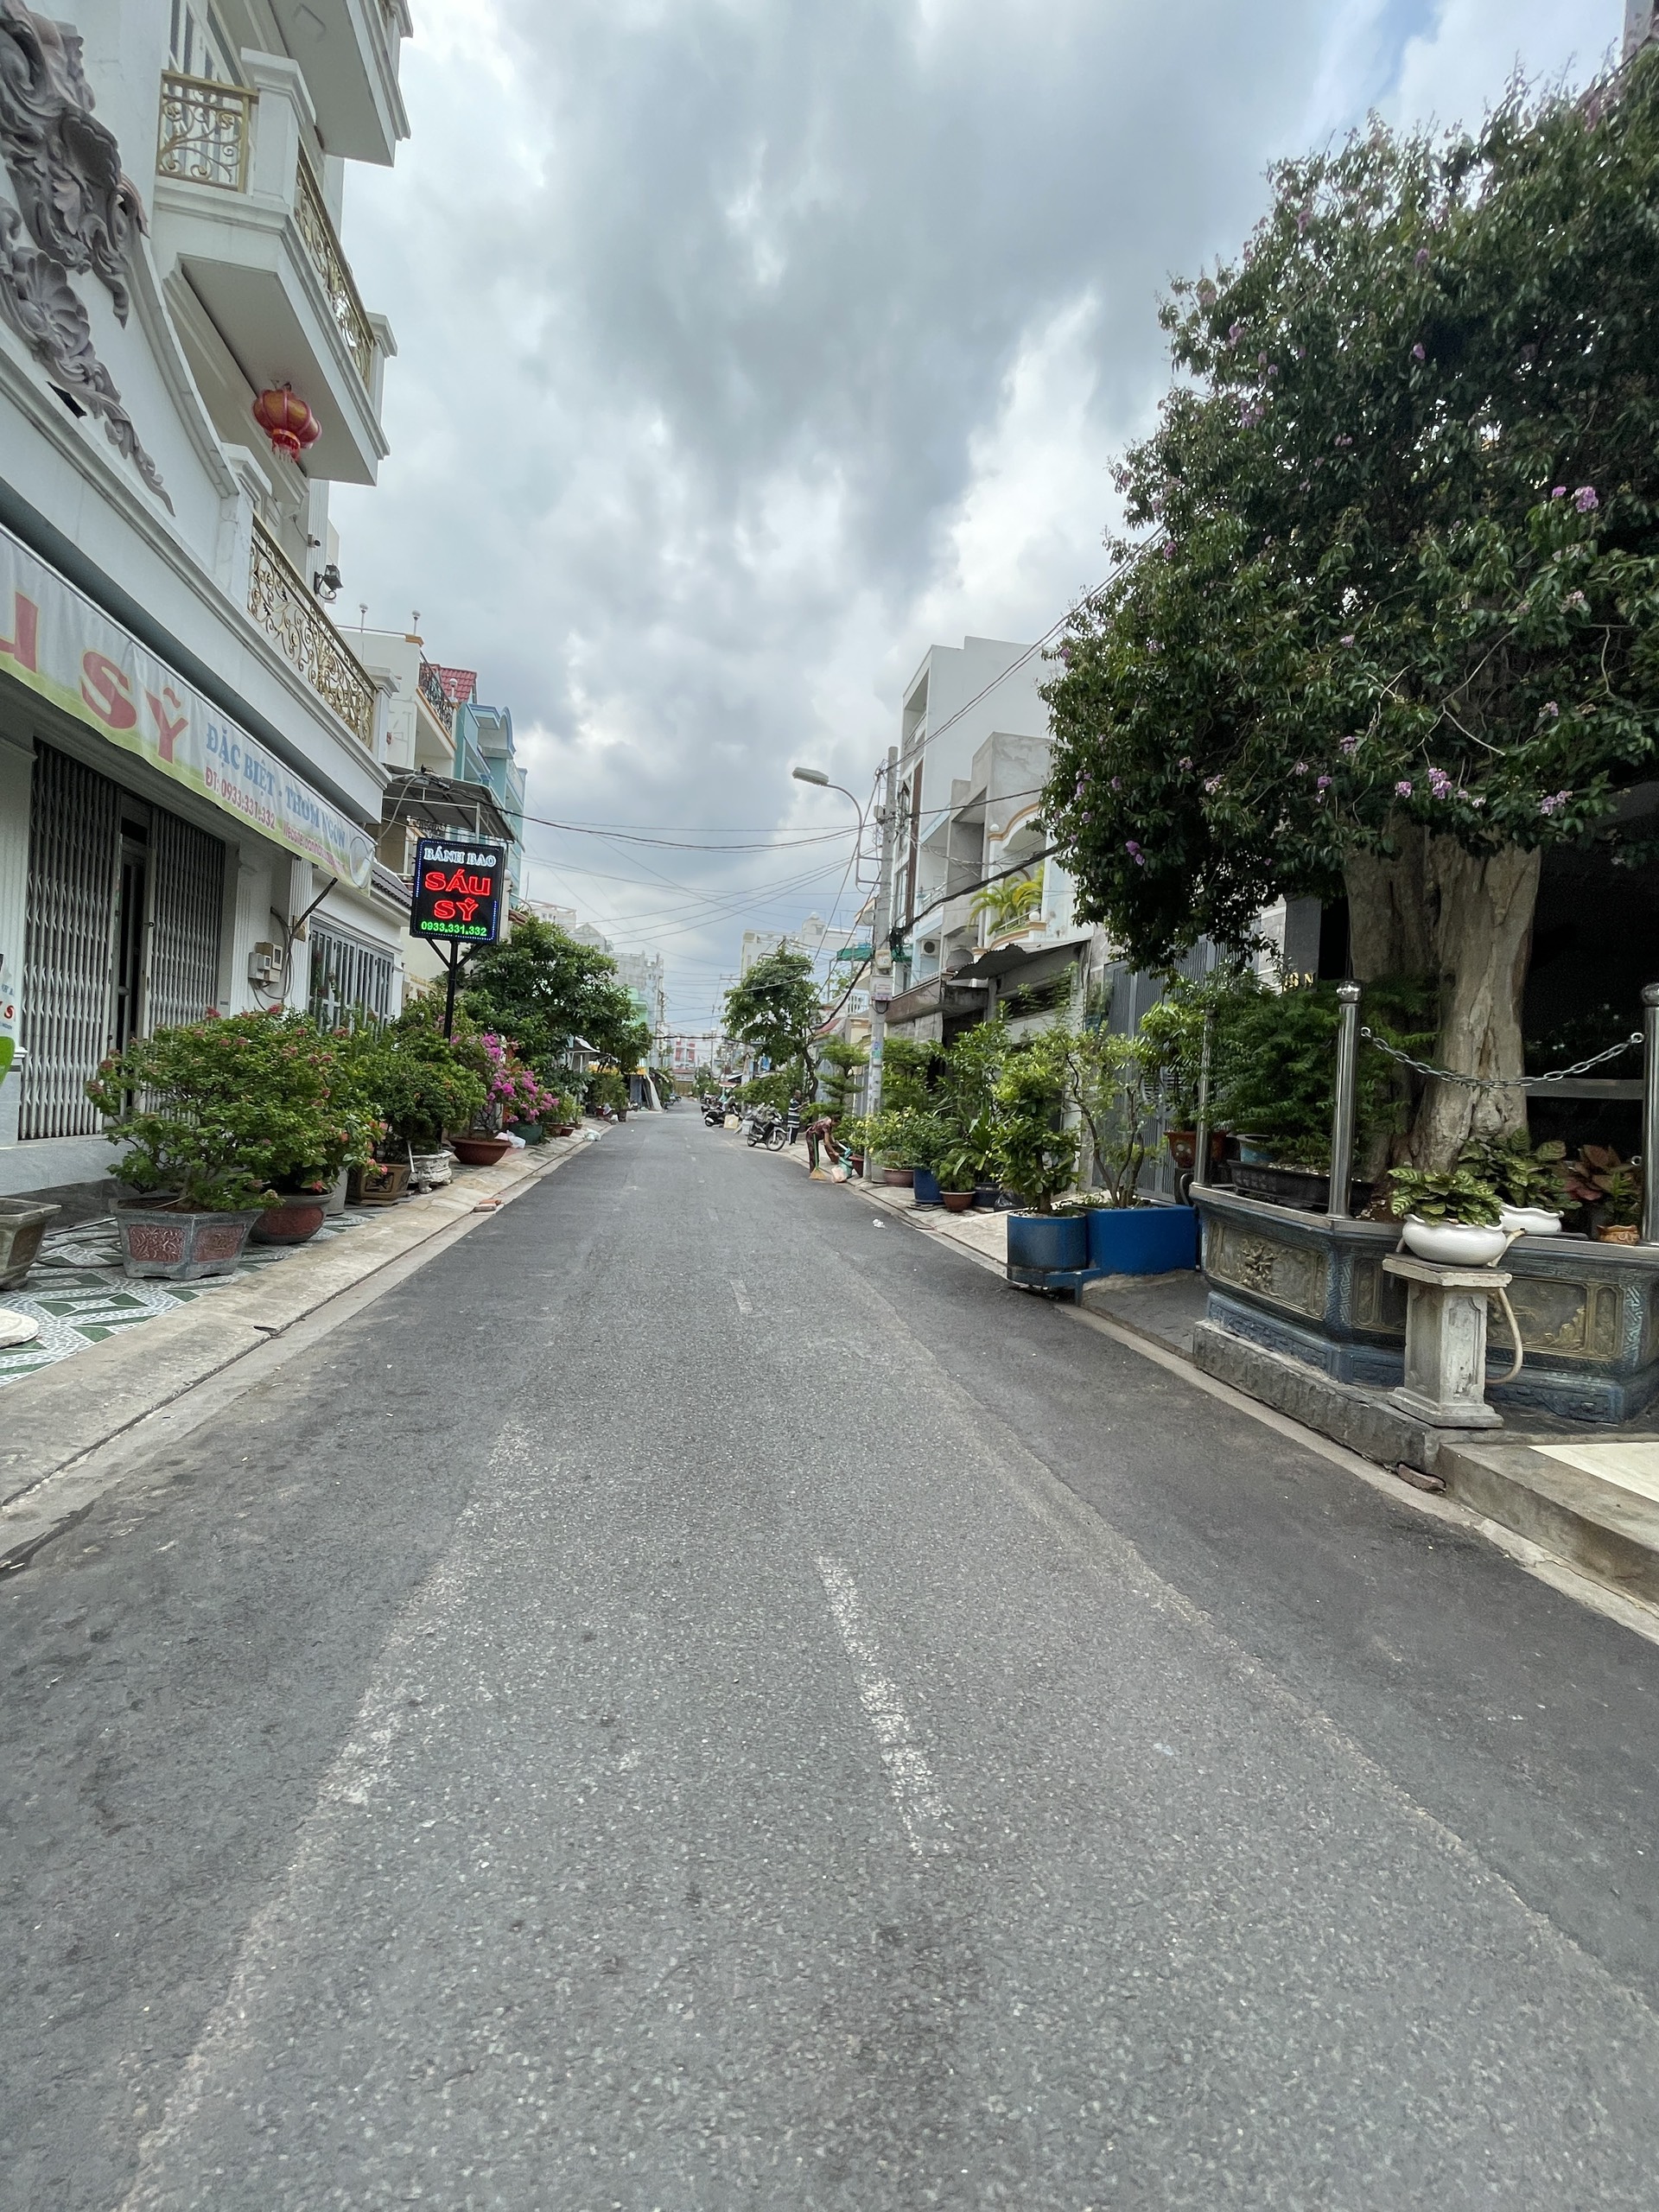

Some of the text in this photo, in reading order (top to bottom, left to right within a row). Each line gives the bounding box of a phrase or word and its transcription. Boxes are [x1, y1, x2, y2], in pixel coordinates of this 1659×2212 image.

[79, 651, 189, 765] SỸ
[206, 722, 241, 770] ĐẶC
[244, 753, 276, 797] BIỆT
[285, 785, 320, 829] THƠM
[423, 845, 497, 868] BÁNH BAO
[424, 867, 491, 896] SÁU
[434, 897, 480, 921] SỸ
[421, 921, 487, 937] 0933.331.332
